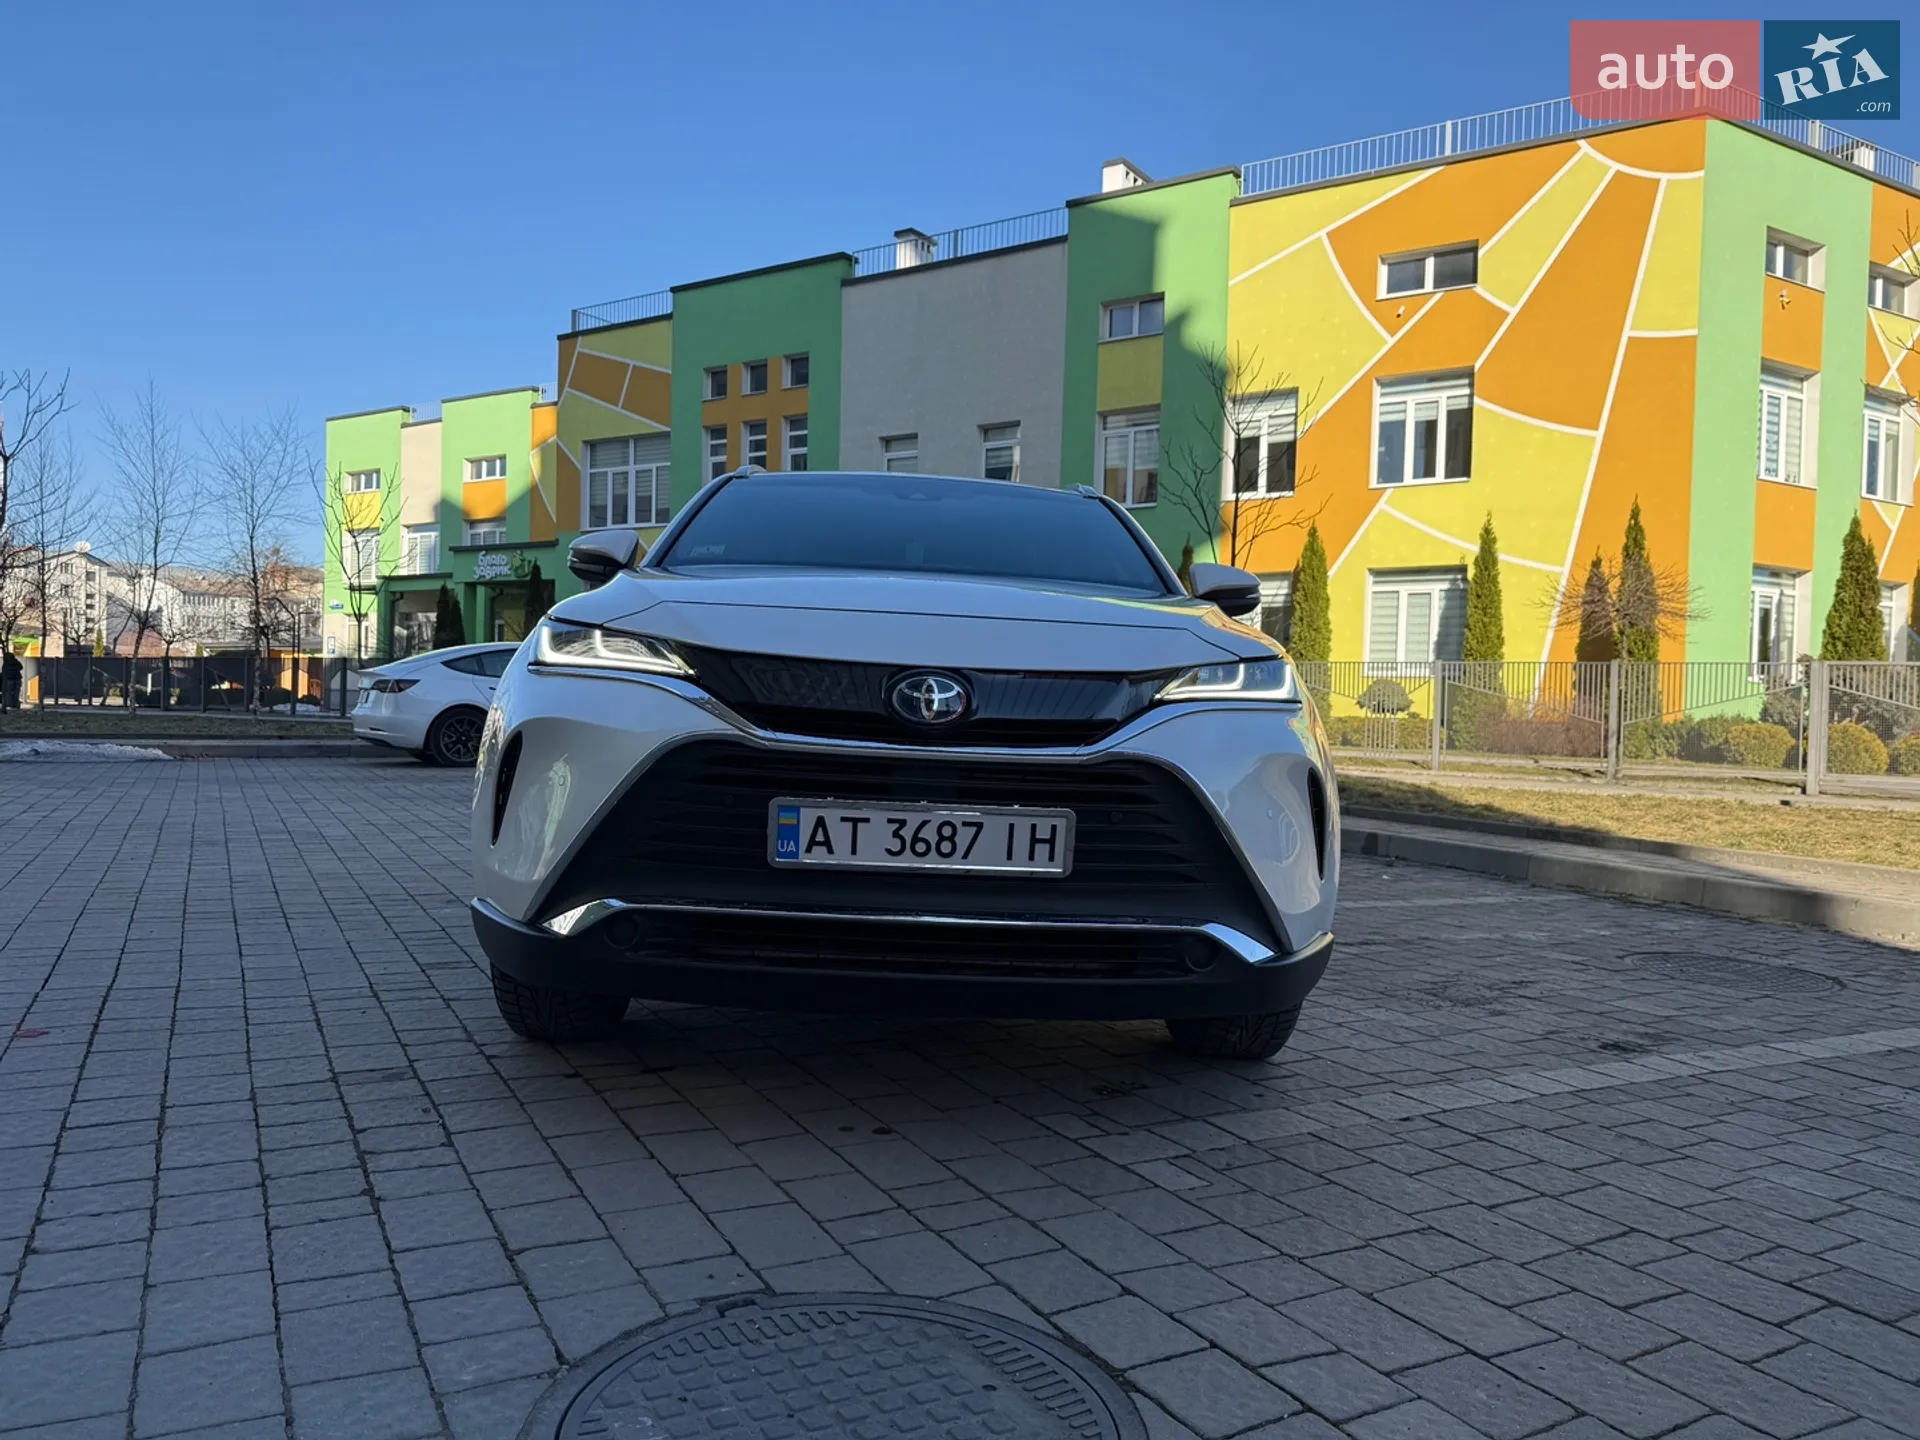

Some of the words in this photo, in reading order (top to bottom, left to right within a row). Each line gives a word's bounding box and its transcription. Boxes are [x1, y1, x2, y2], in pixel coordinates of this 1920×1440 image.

[777, 839, 797, 853] UA
[804, 815, 871, 856] AT
[884, 818, 985, 860] 3687
[1006, 822, 1058, 863] IH
